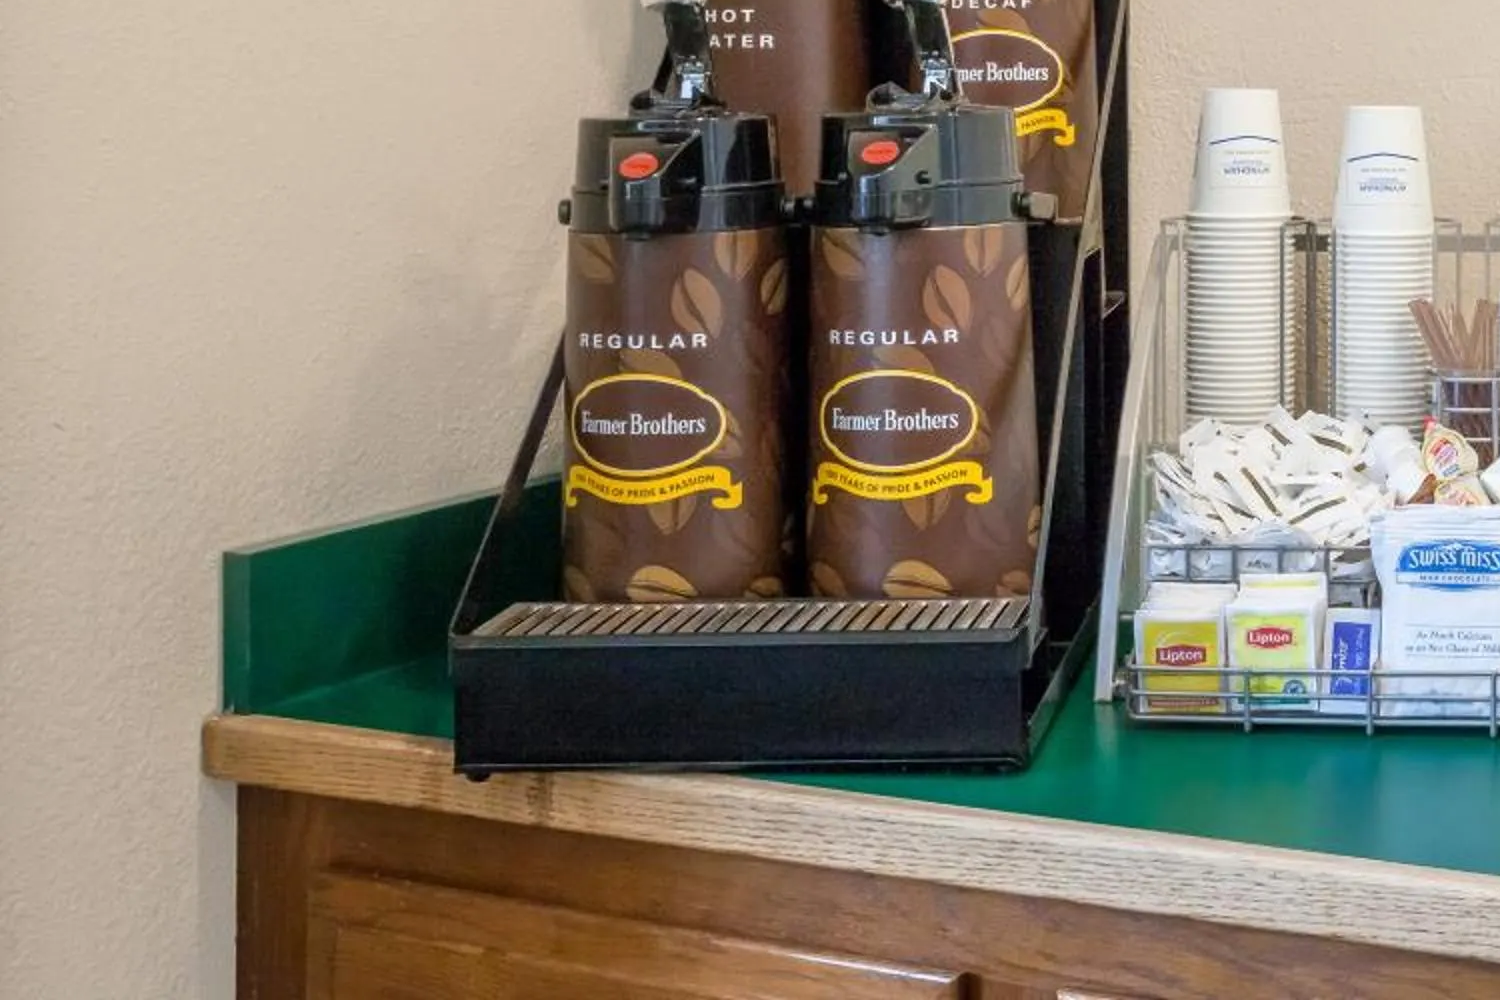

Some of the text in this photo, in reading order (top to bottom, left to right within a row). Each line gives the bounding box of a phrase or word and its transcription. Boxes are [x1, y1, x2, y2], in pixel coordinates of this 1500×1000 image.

[704, 9, 755, 23] HOT
[708, 34, 775, 49] ATER
[956, 61, 1049, 81] mer Brothers
[579, 333, 708, 349] REGULAR
[829, 329, 960, 345] REGULAR
[581, 410, 706, 435] Farmer Brothers
[832, 407, 959, 431] Farmer Brothers
[669, 473, 715, 494] PASSION
[1409, 547, 1500, 571] SWISS MISS
[1250, 630, 1291, 644] Lipton
[1159, 649, 1203, 664] Lipton
